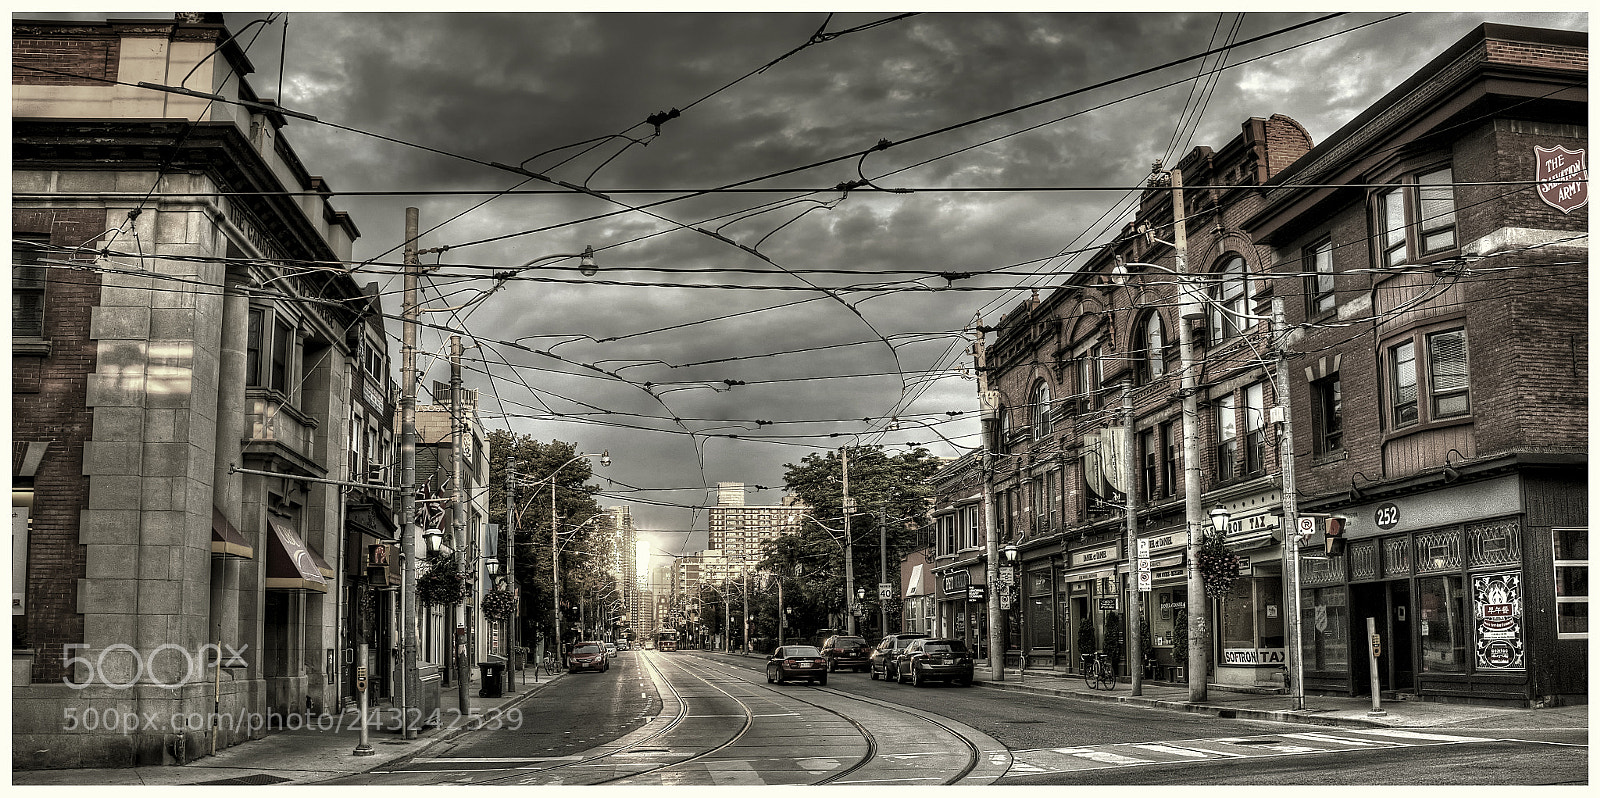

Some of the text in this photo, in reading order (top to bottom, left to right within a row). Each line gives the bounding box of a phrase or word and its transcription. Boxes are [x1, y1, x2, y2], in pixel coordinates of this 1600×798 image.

[1545, 154, 1565, 173] THE
[1541, 160, 1581, 193] SALVATION
[1558, 178, 1581, 202] ARMY
[1249, 516, 1266, 530] TAX
[1377, 506, 1398, 526] 252
[1225, 651, 1257, 663] SOFTRON
